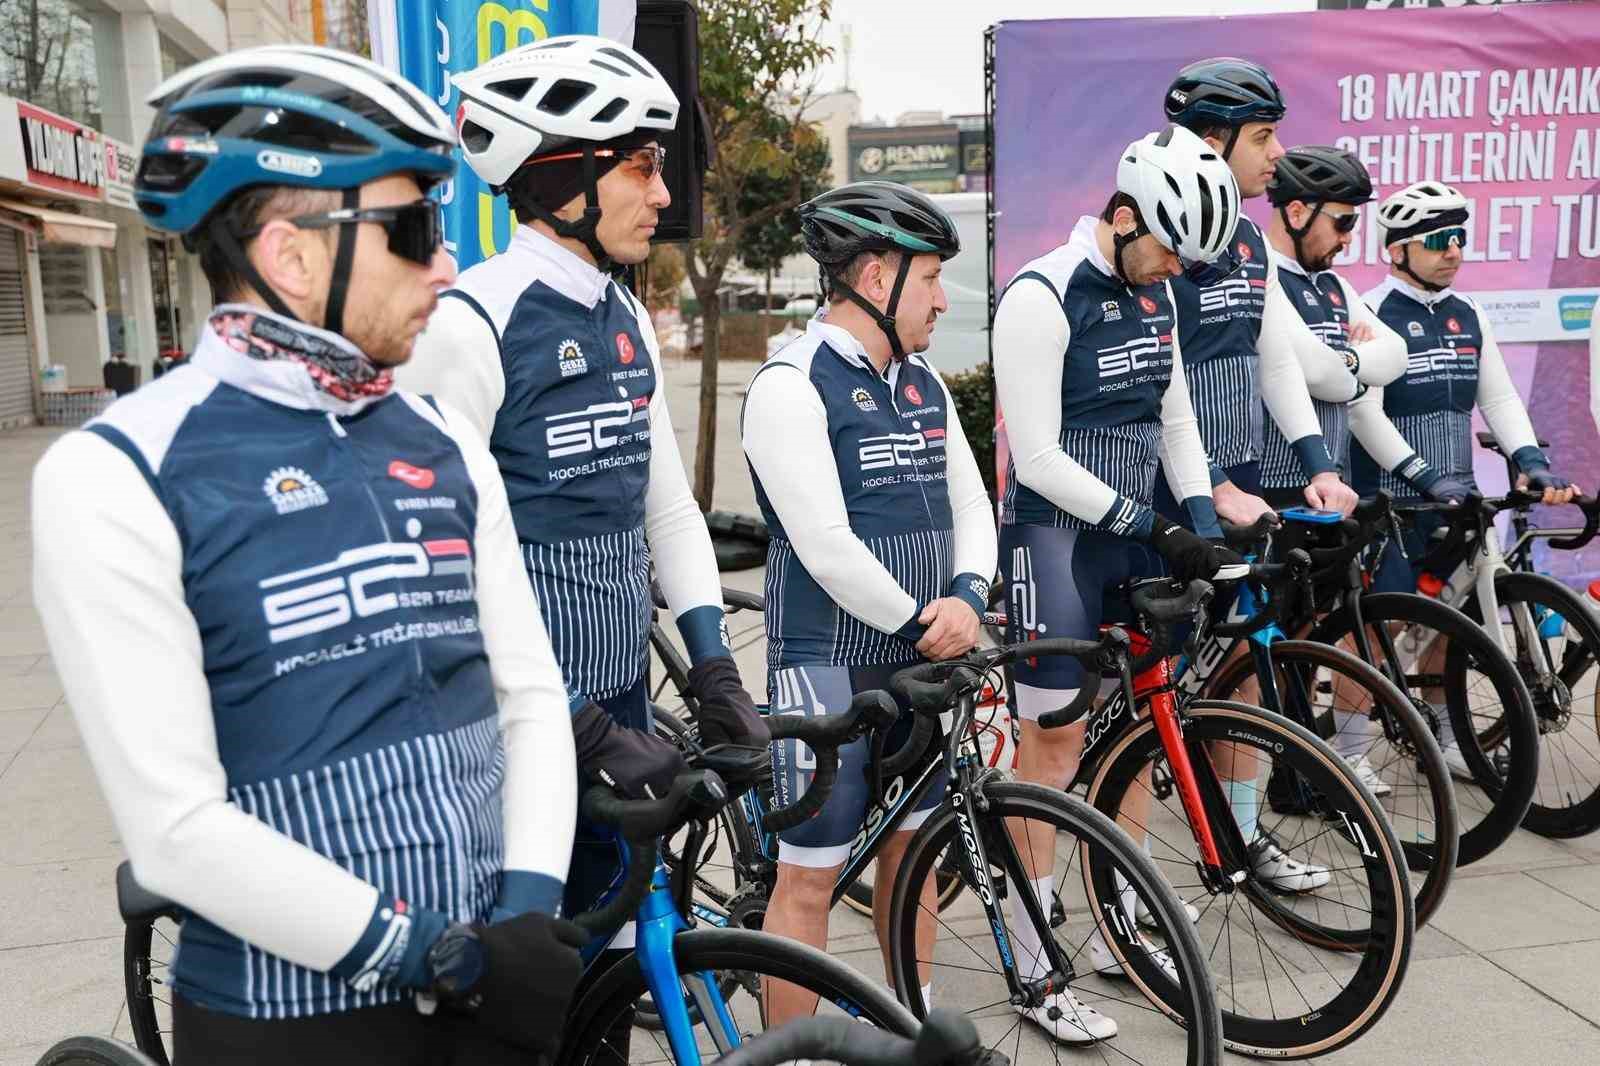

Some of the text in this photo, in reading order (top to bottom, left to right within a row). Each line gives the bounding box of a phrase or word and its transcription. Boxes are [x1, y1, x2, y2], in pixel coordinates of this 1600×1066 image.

[1337, 74, 1376, 122] 18
[1385, 71, 1481, 120] MART
[957, 812, 992, 906] MOSSO
